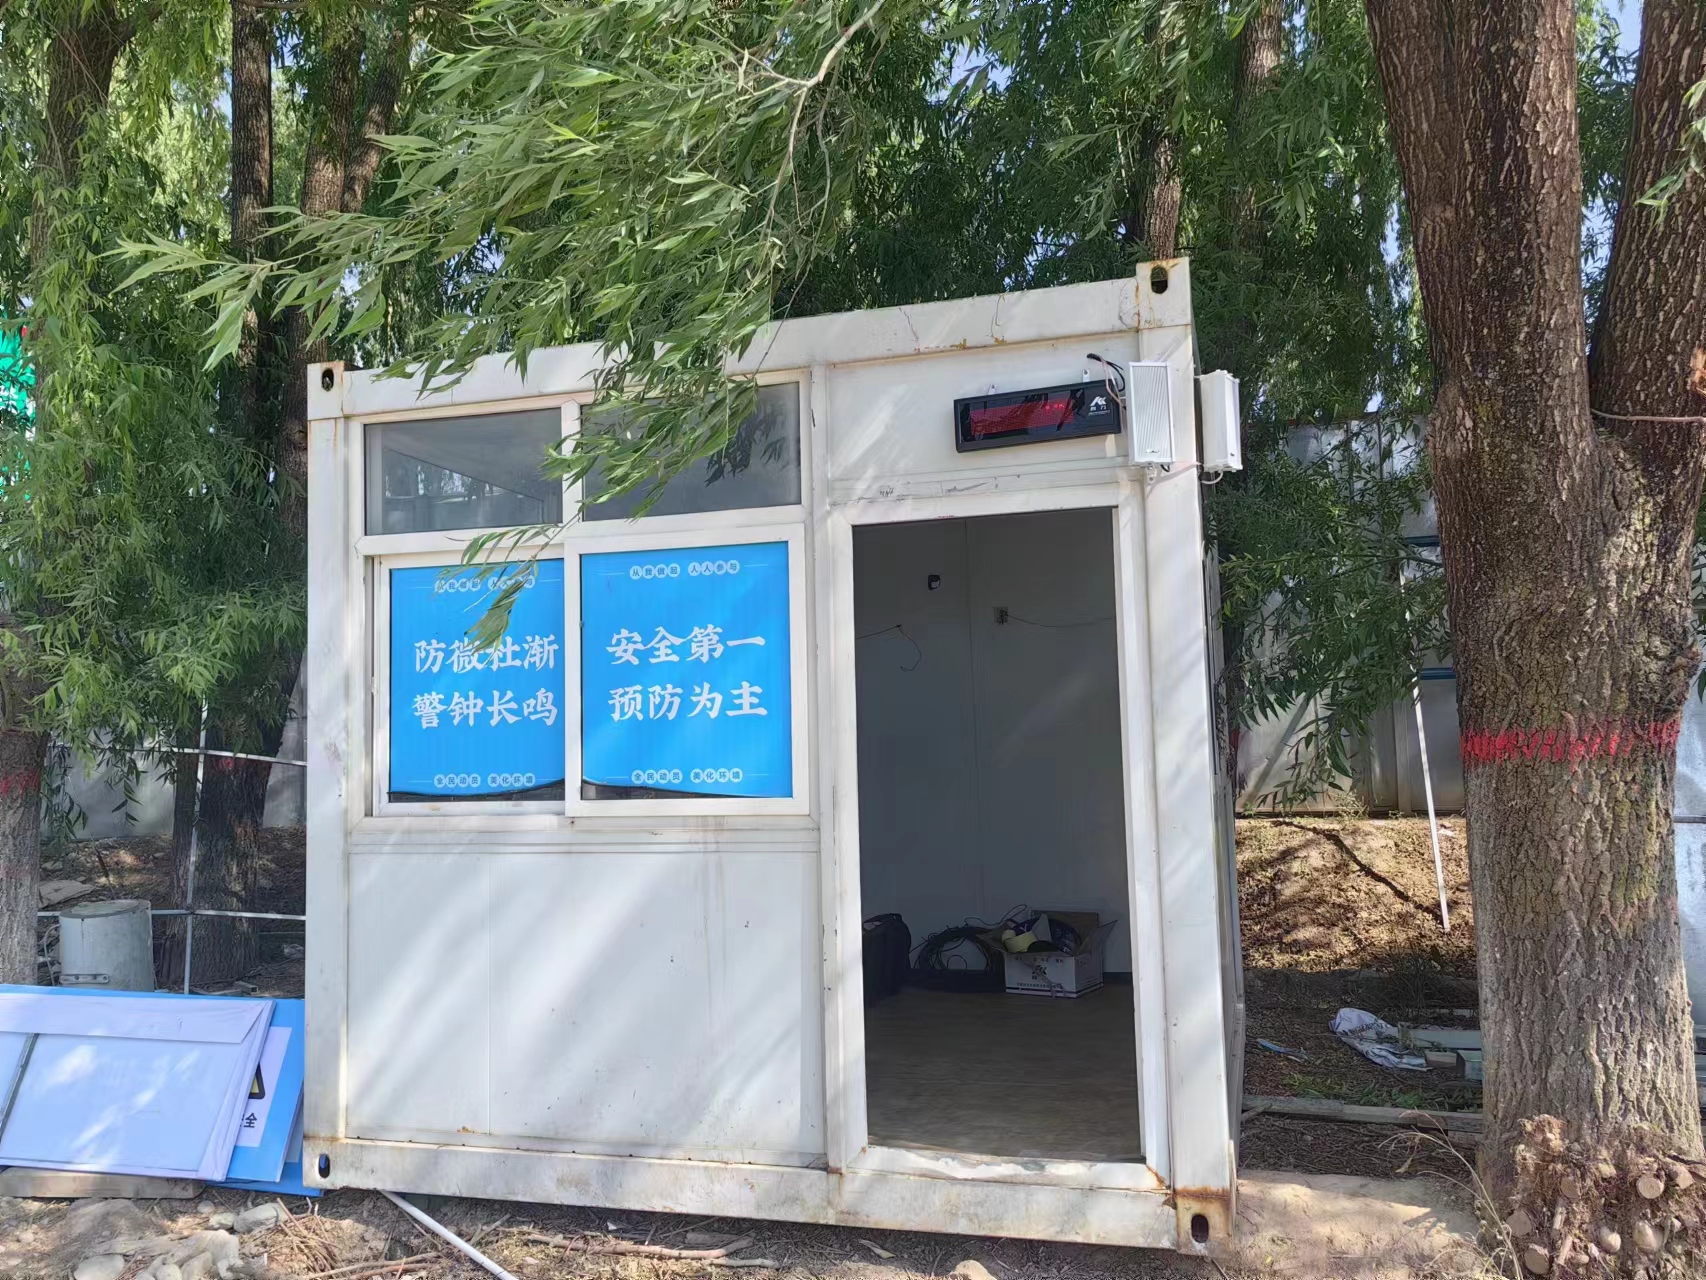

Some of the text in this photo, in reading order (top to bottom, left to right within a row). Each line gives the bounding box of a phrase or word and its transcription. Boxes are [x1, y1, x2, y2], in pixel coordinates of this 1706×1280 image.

[630, 561, 739, 579] 从我做起 人人参与
[414, 634, 560, 674] 防微杜渐
[606, 624, 766, 665] 安全第一
[412, 688, 558, 729] 警钟长鸣
[608, 681, 768, 722] 预防为主
[435, 774, 533, 787] 全民动员 美化环境
[632, 769, 741, 783] 全民动员 美化环境
